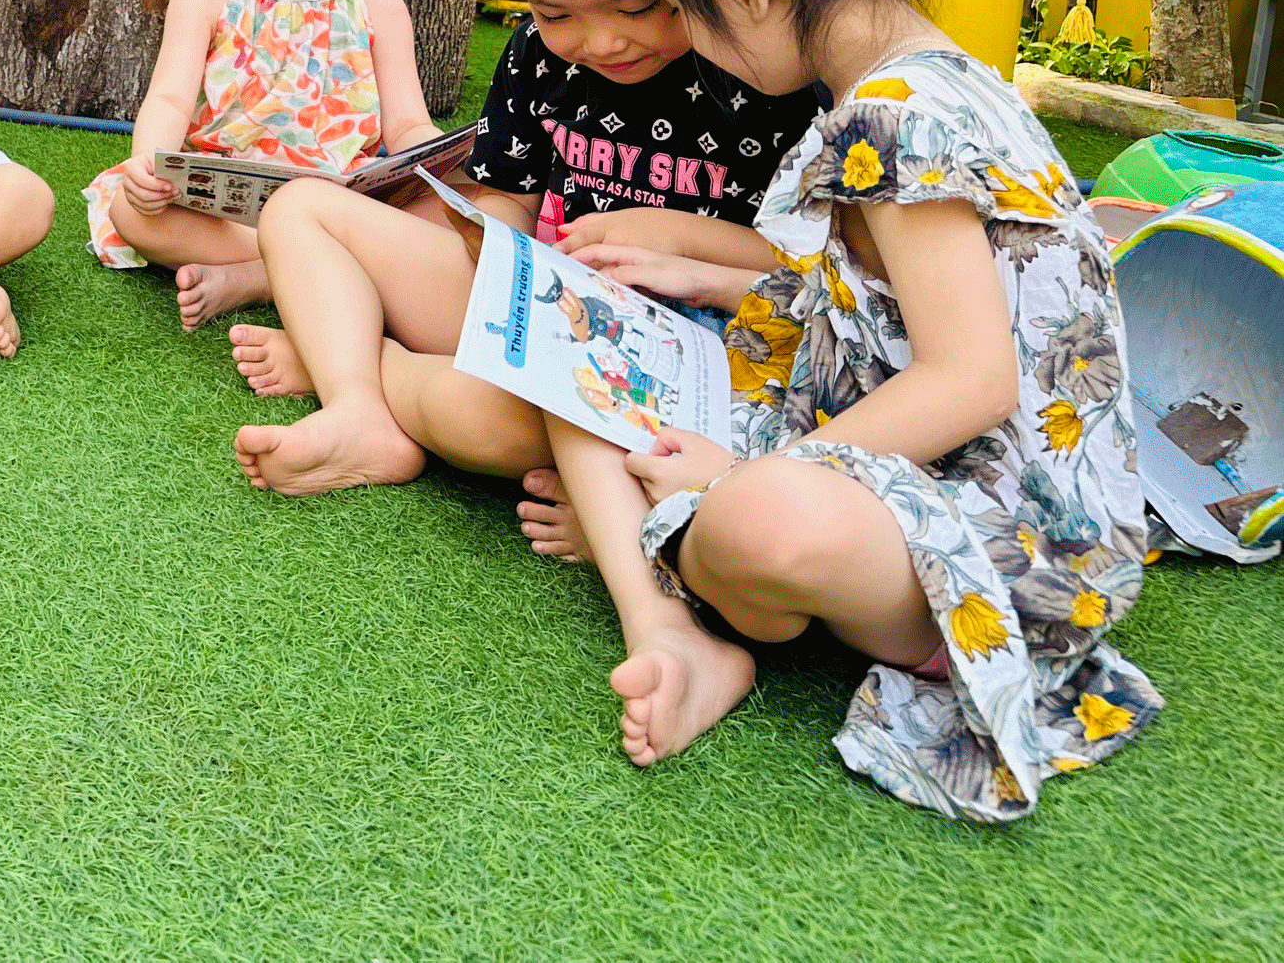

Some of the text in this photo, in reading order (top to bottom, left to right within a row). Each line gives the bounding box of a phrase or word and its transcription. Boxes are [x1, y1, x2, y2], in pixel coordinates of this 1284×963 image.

[648, 152, 728, 199] SKY
[606, 181, 623, 196] AS
[623, 186, 632, 200] A
[633, 189, 666, 208] STAR
